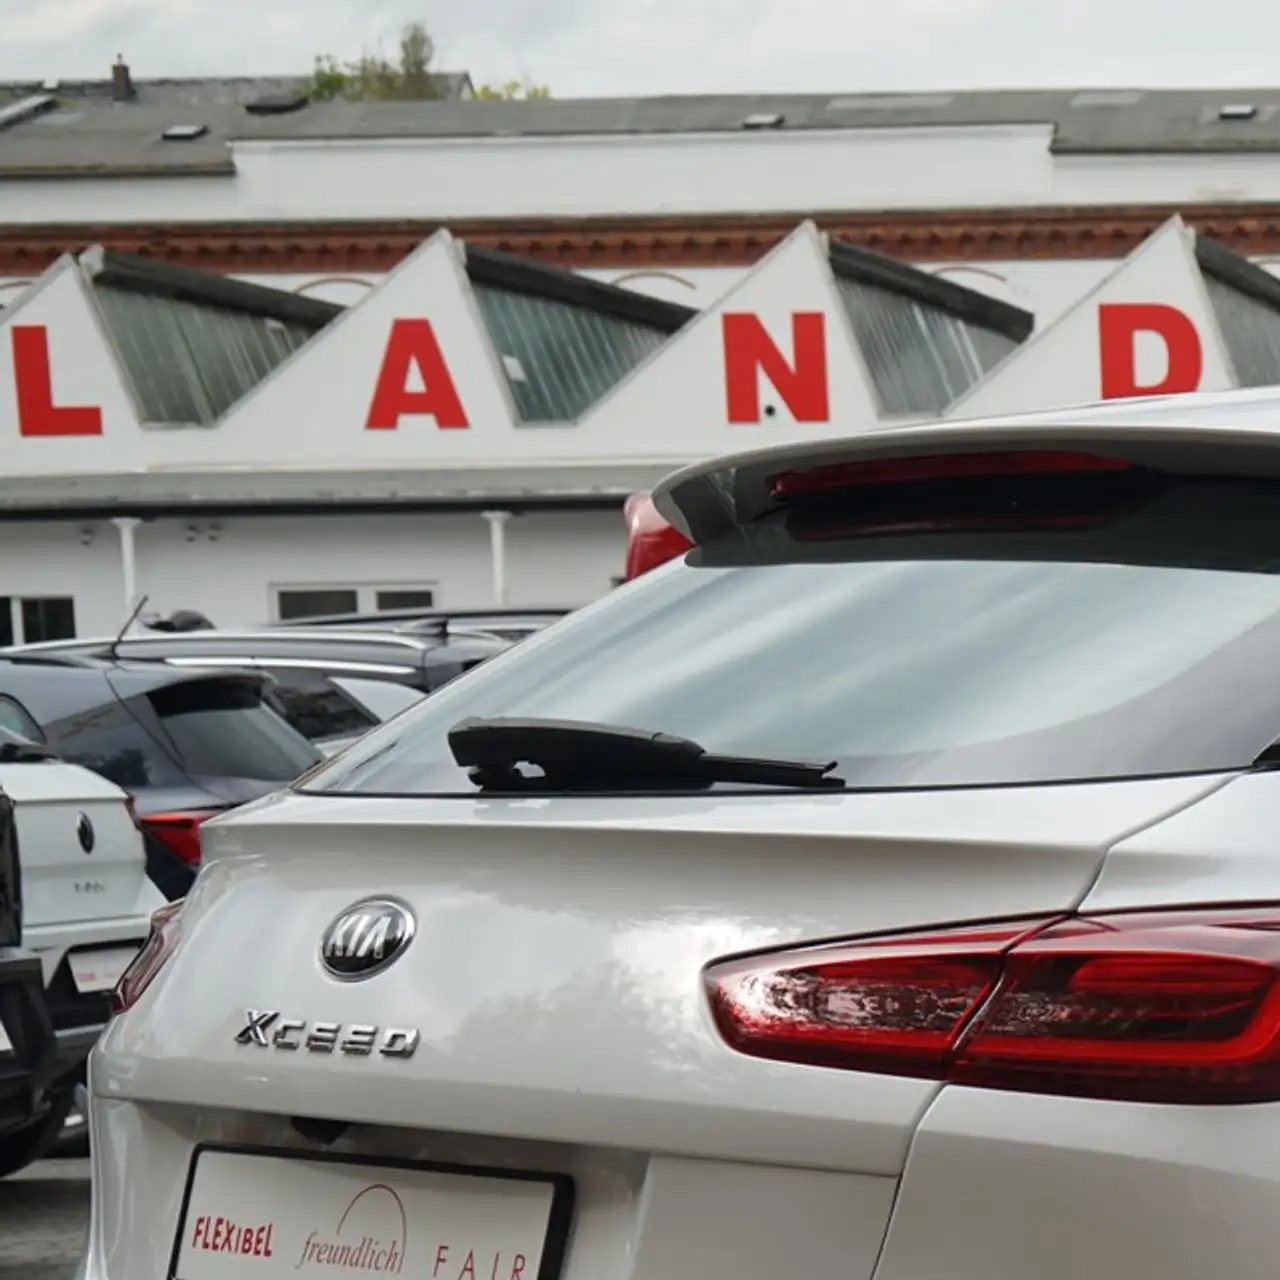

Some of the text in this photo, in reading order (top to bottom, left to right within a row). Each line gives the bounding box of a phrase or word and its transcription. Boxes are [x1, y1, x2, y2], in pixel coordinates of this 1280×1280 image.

[324, 913, 392, 960] KIA
[191, 1216, 273, 1258] FLEXIBEL
[295, 1231, 405, 1274] freundlich
